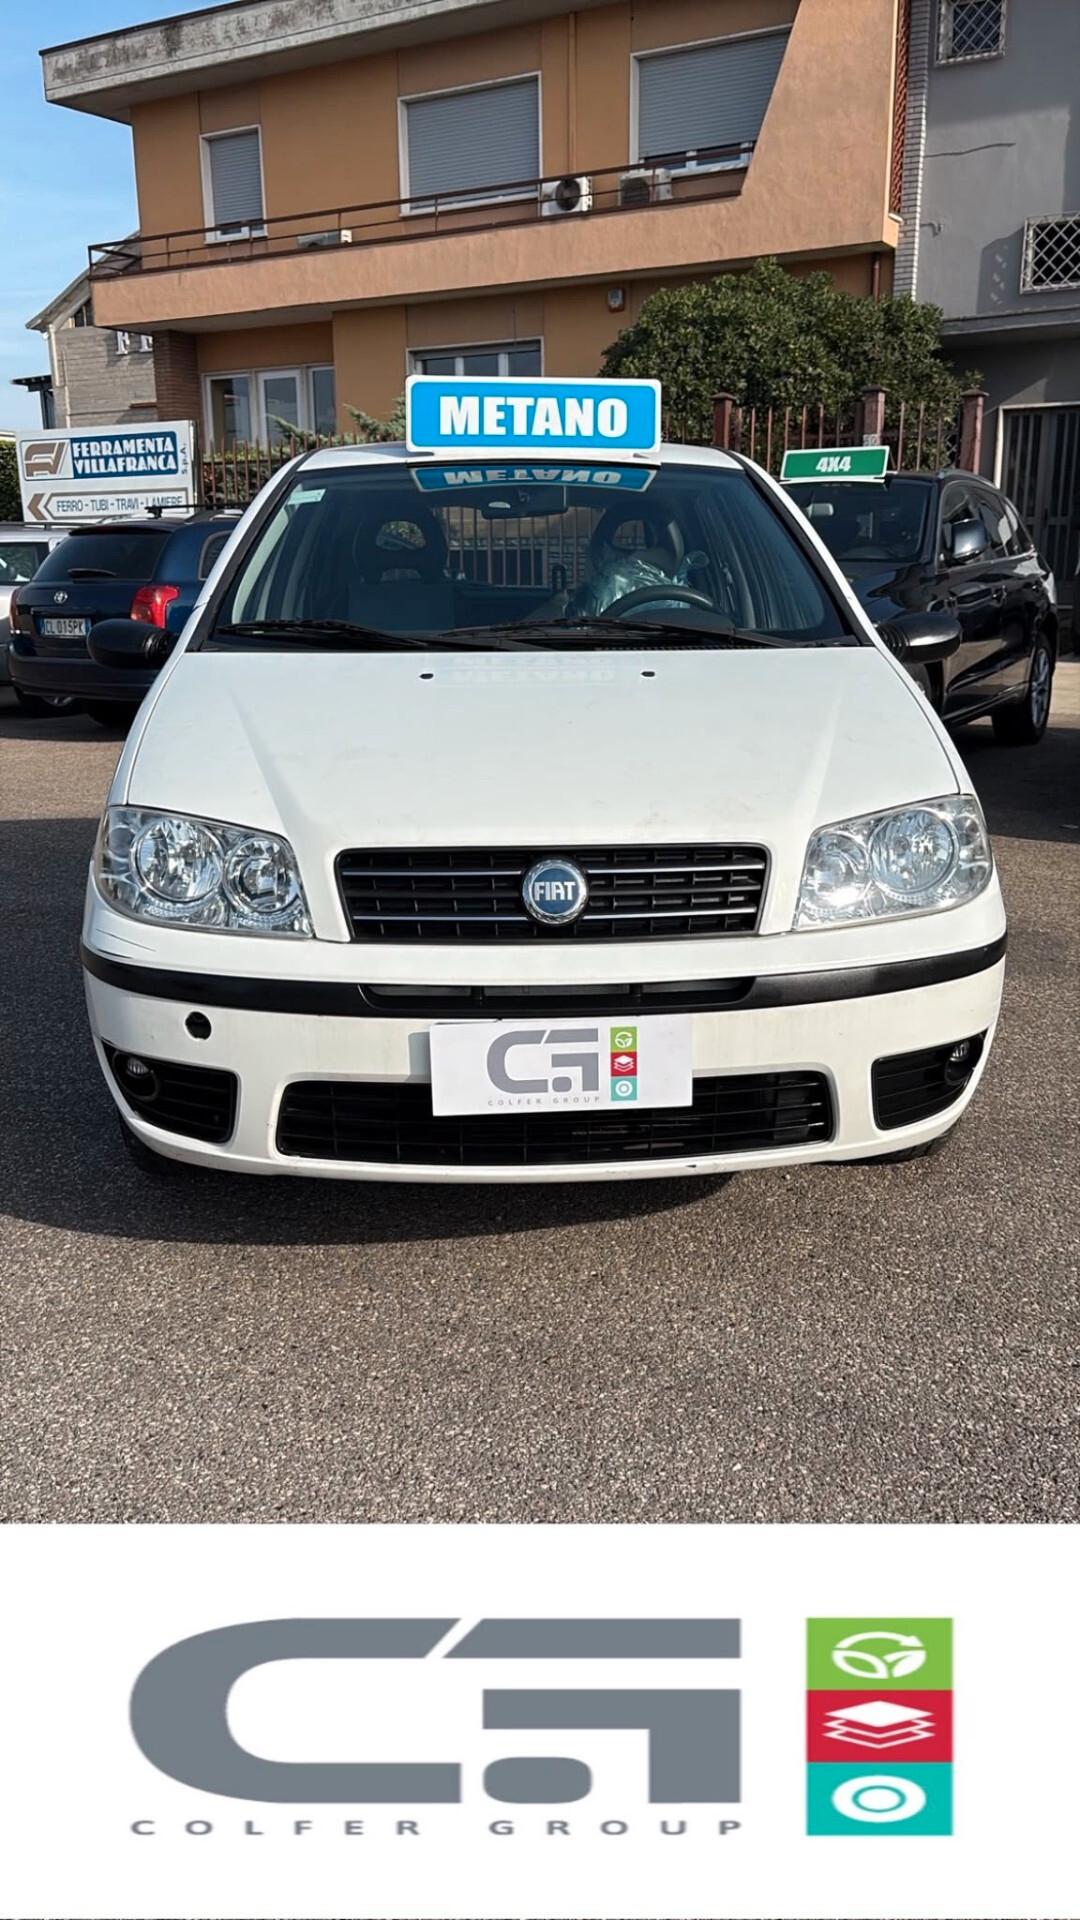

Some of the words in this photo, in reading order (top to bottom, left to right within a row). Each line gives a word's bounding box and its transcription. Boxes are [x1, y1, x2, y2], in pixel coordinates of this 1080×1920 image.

[440, 396, 628, 438] METANO
[72, 437, 174, 458] FERRAMENTA
[73, 454, 177, 474] VILLAFRANCA
[56, 499, 82, 513] FERRO
[90, 498, 109, 512] TUBI
[115, 497, 139, 511] TRAVI
[534, 881, 576, 901] FIAT
[487, 1098, 542, 1106] COLFER
[552, 1096, 600, 1105] GROUP
